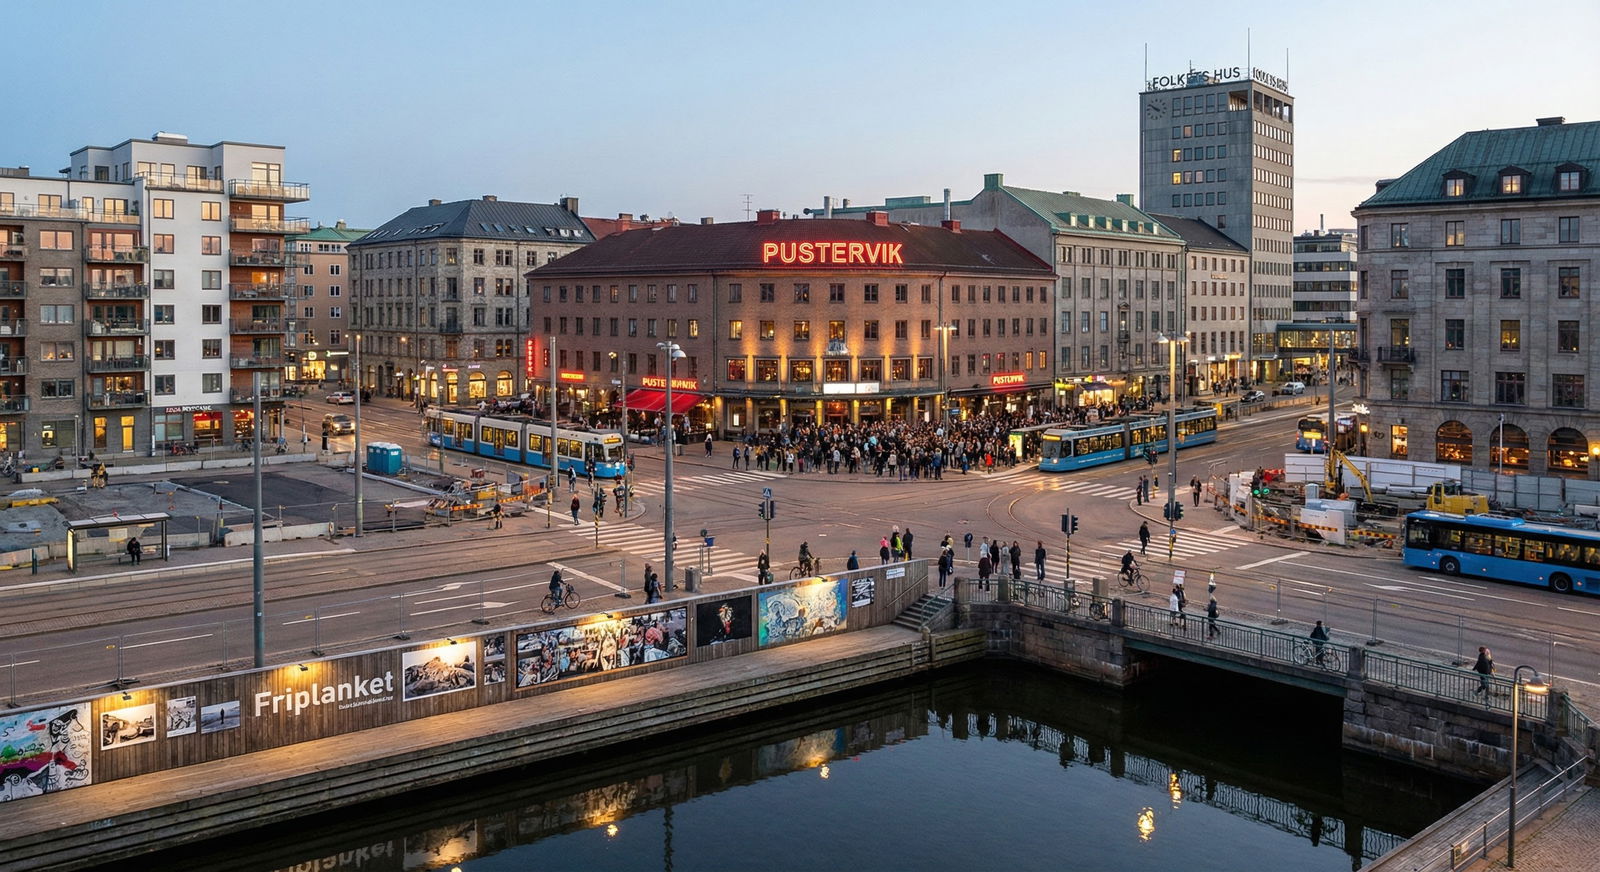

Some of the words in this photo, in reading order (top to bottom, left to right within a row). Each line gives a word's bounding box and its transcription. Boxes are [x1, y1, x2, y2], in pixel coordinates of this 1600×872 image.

[1152, 71, 1210, 89] FOLKETS
[1214, 66, 1241, 82] HUS
[763, 242, 904, 264] PUSTERVIK
[254, 671, 394, 717] Friplanket
